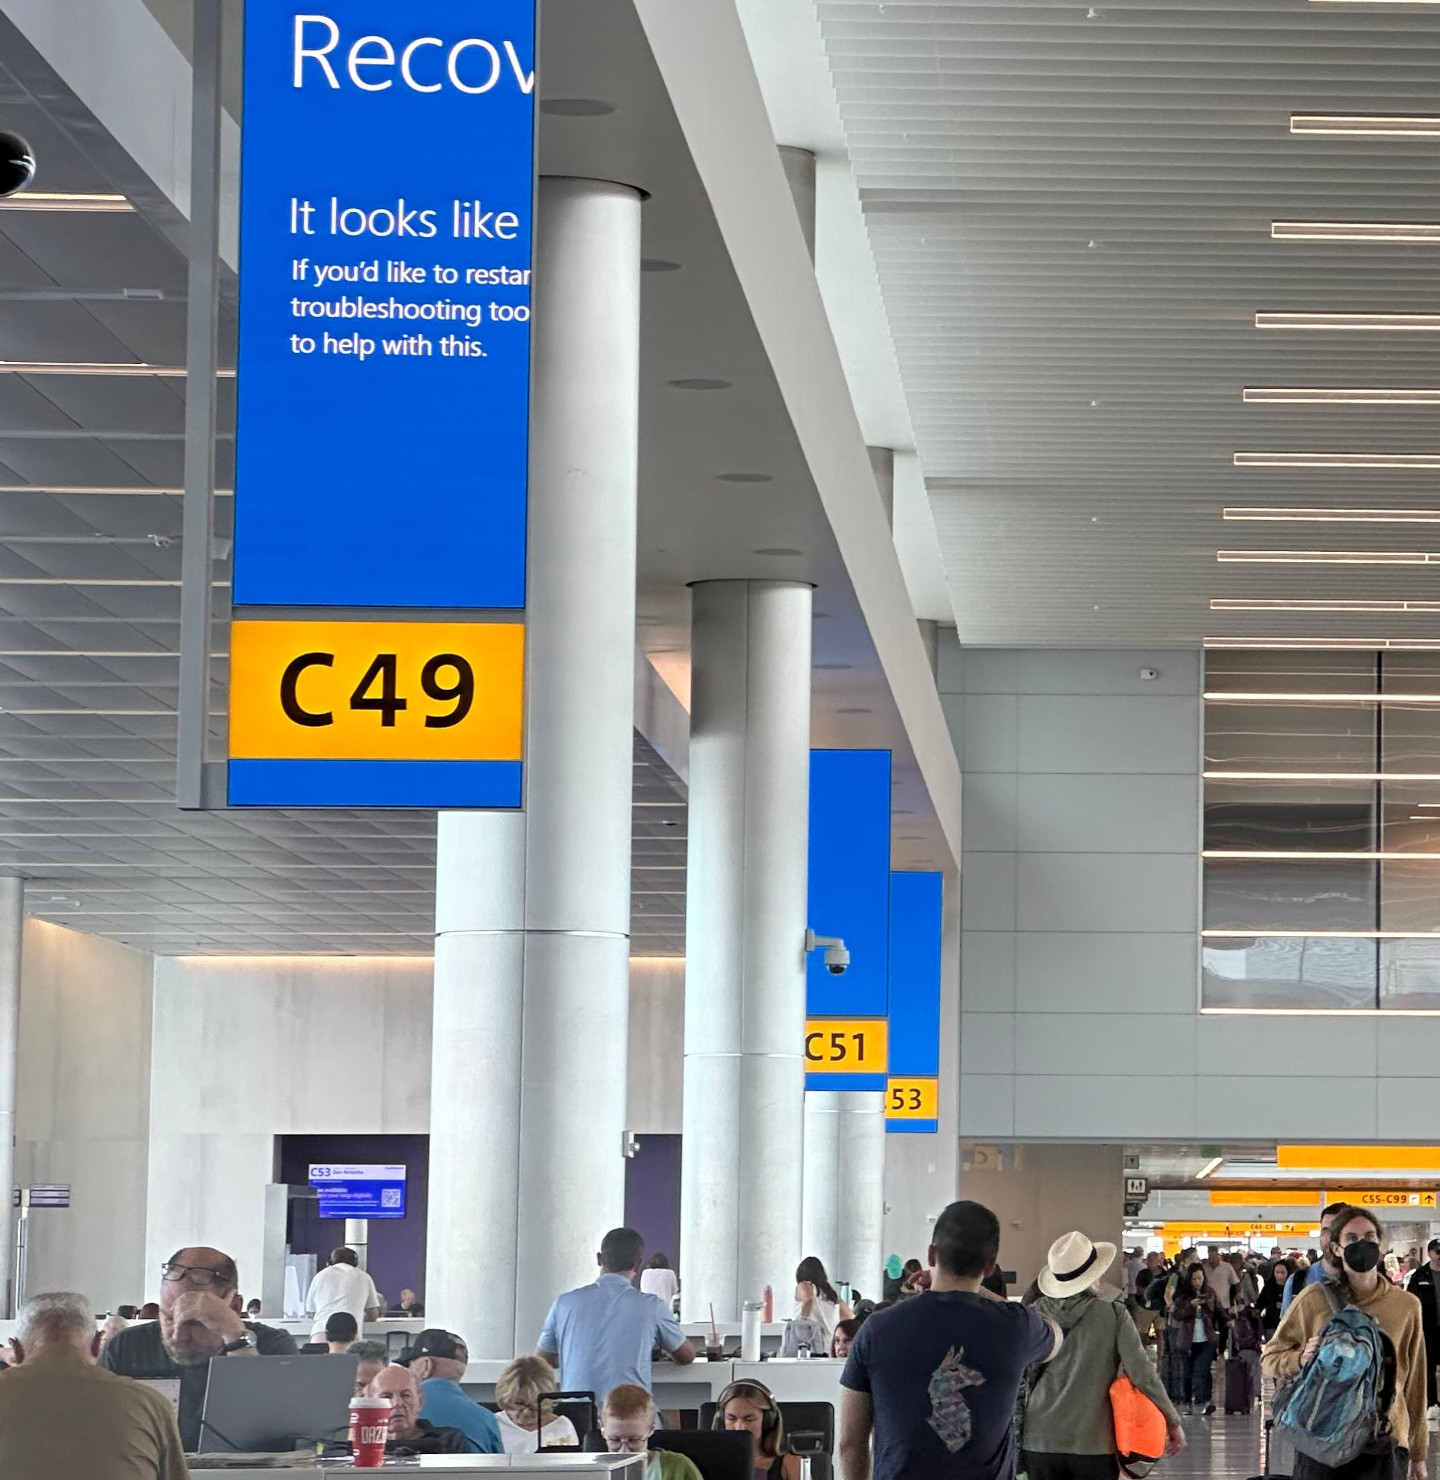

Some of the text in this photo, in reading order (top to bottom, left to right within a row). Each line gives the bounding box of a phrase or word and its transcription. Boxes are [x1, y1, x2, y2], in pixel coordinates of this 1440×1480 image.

[293, 14, 534, 94] Recov
[290, 197, 519, 240] It looks like
[292, 258, 532, 288] If you'd like to restar
[290, 296, 531, 327] troubleshooting too
[290, 331, 488, 361] to help with this.
[280, 652, 474, 728] C49
[805, 1033, 864, 1061] C51
[884, 1088, 921, 1110] 53
[310, 1168, 331, 1176] C53
